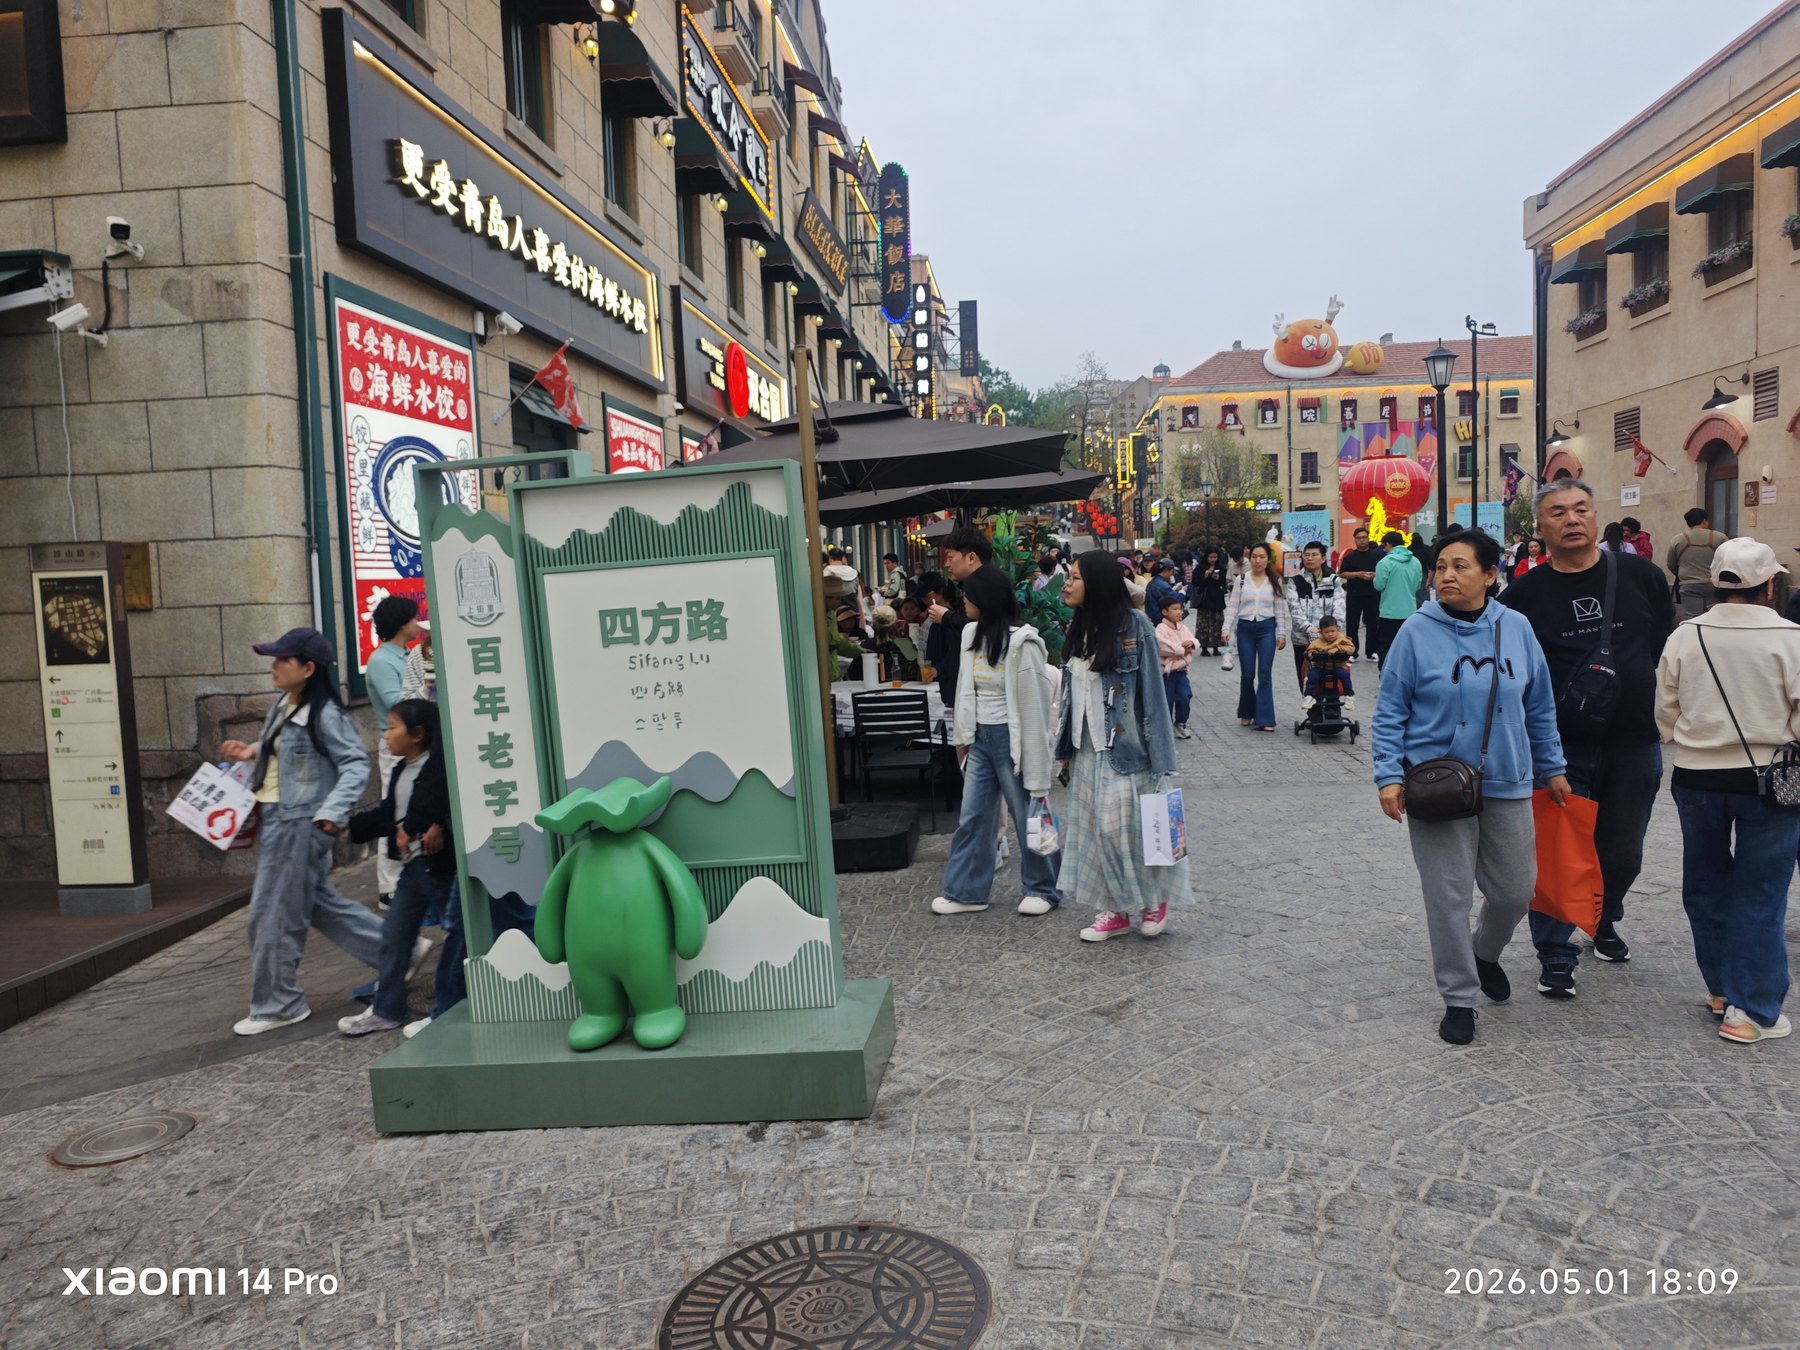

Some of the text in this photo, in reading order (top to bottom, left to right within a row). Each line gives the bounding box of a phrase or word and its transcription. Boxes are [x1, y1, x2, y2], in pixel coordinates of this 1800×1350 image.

[401, 138, 648, 334] 更受青岛人喜爱的海鲜水饺
[884, 188, 905, 294] 大華飯店
[346, 321, 467, 385] 更受青岛人喜爱的
[366, 362, 457, 421] 海鲜水饺
[598, 598, 729, 647] 四方路
[629, 652, 710, 670] Sifang Lu
[467, 636, 524, 863] 百年老字号
